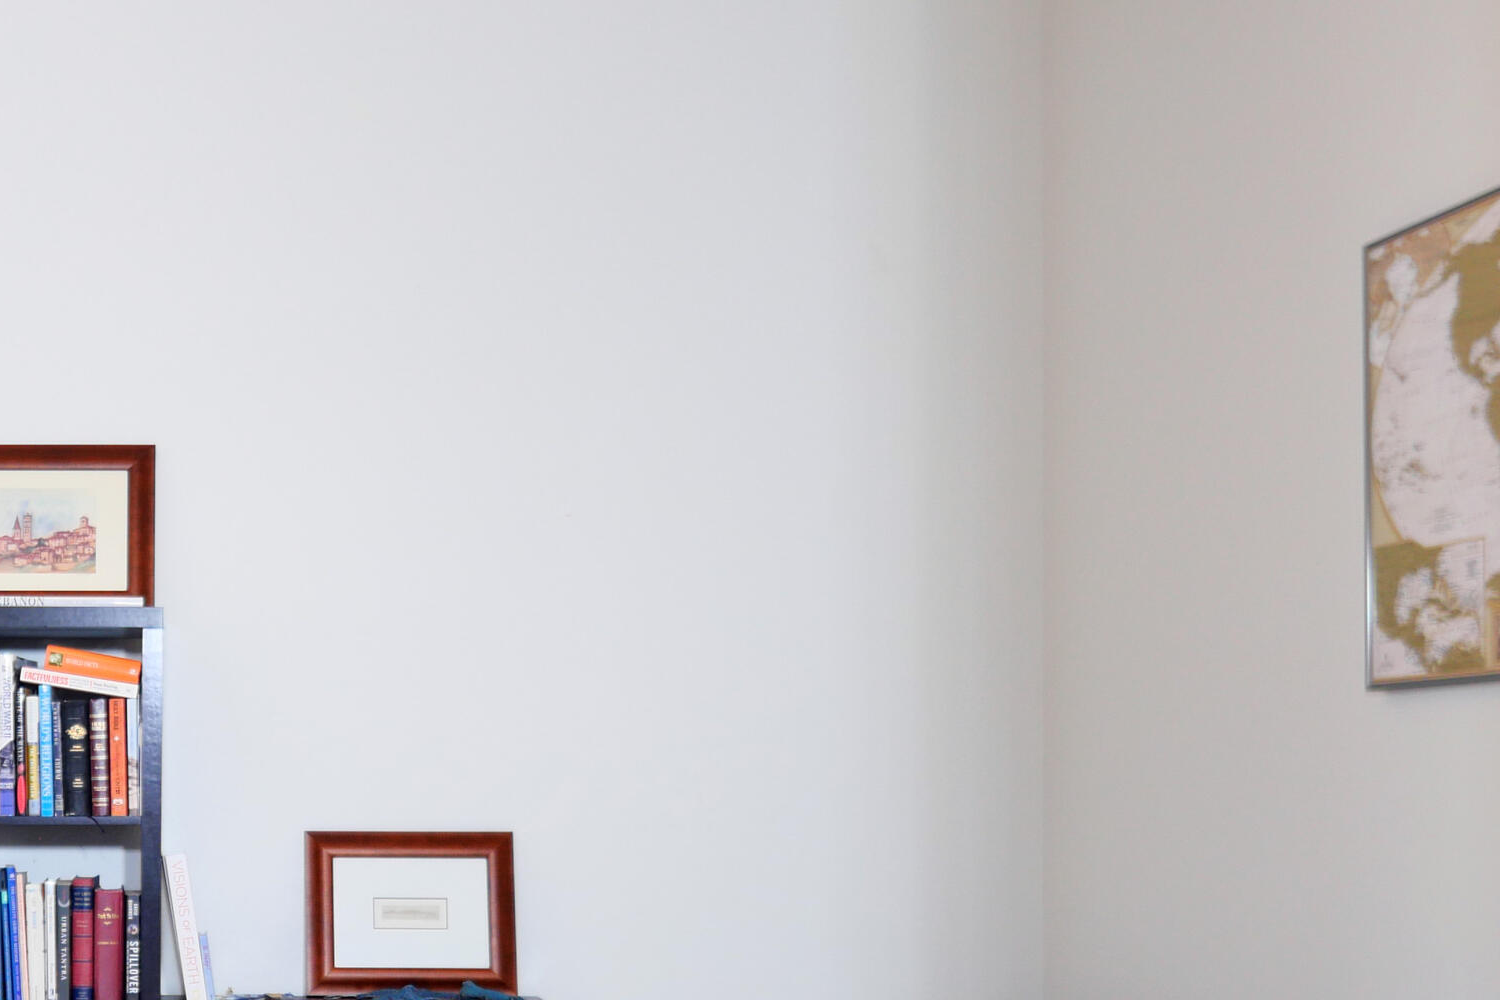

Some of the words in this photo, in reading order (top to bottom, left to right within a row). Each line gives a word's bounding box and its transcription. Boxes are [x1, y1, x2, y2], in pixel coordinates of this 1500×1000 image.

[3, 677, 13, 708] WORLD
[24, 671, 69, 685] FACTFULNESS
[4, 710, 13, 731] WAR
[43, 745, 51, 797] RELIGIONS
[172, 860, 189, 917] VISIONS
[130, 941, 138, 994] SPILLOVER
[180, 936, 199, 985] EARTH
